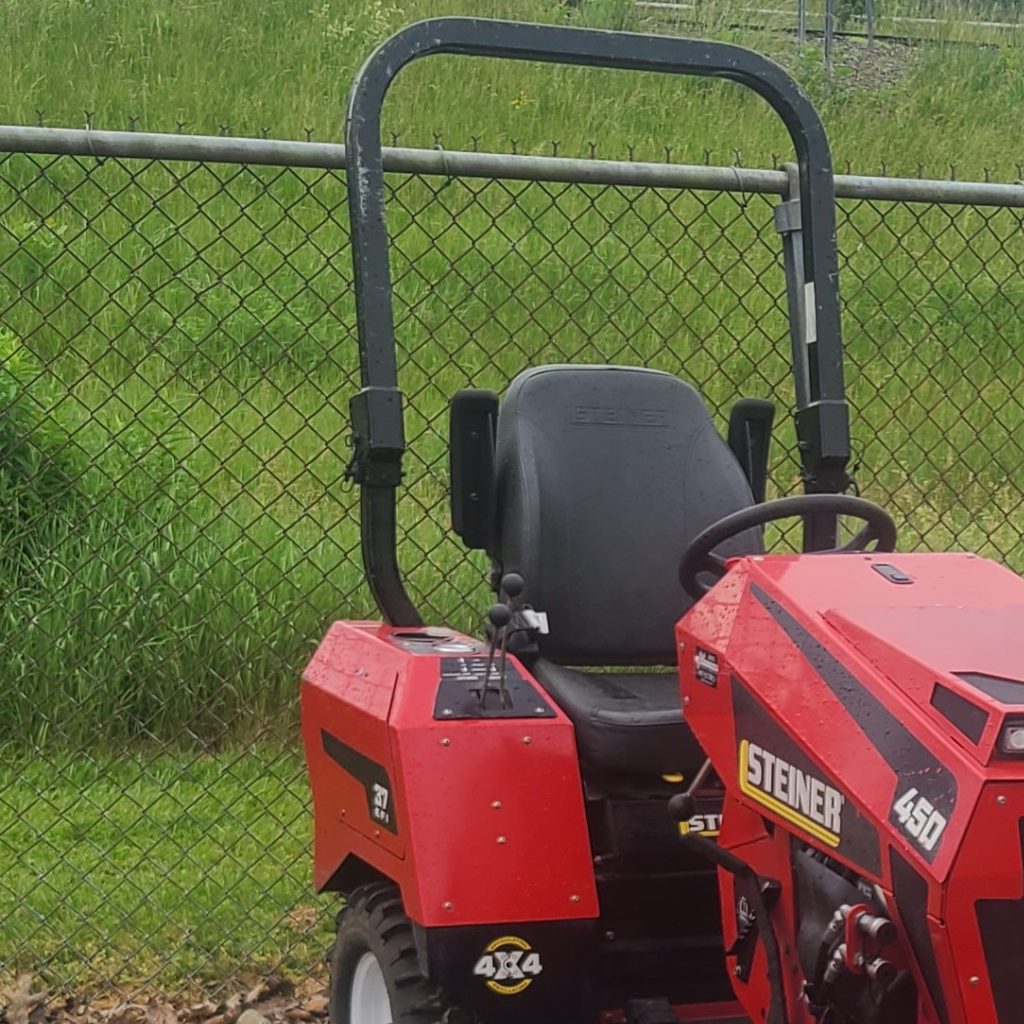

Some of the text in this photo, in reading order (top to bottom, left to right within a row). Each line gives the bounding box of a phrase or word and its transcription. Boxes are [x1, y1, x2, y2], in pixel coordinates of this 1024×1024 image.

[373, 783, 389, 810] 37
[747, 743, 842, 834] STEINER
[892, 787, 947, 851] 450
